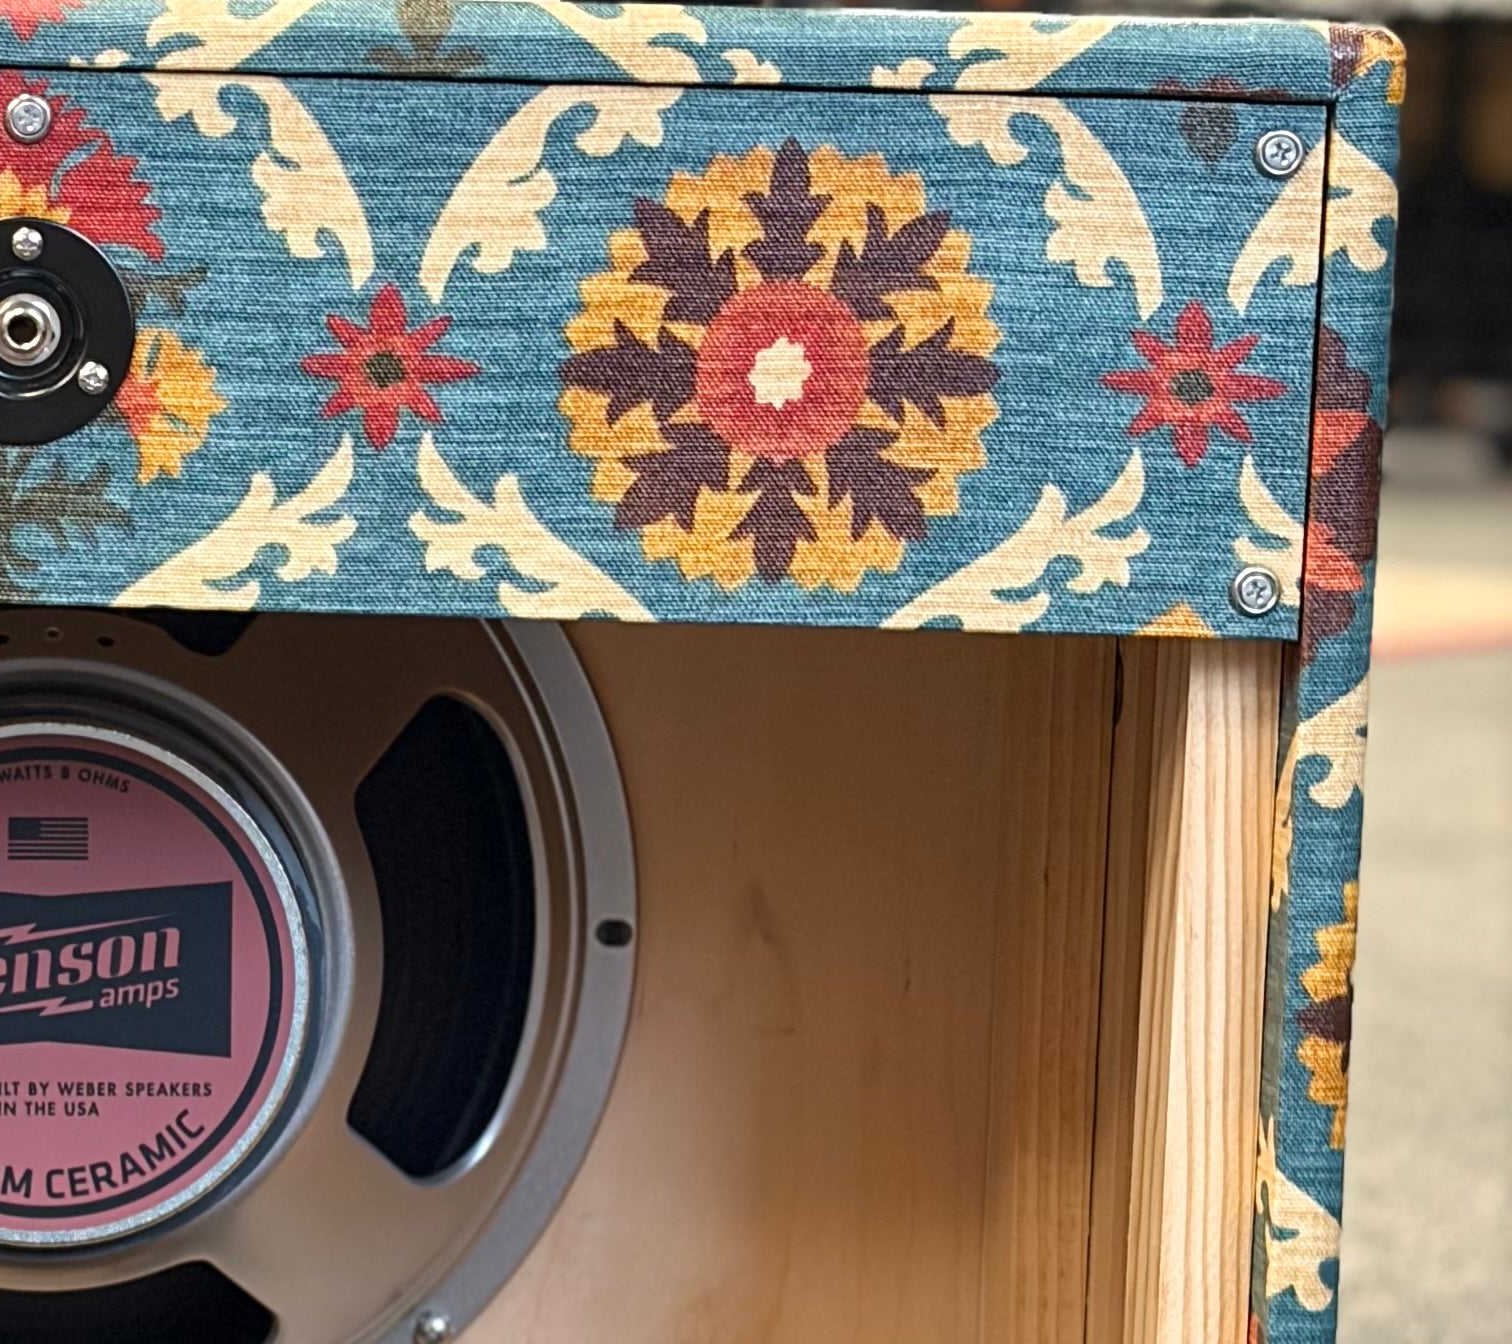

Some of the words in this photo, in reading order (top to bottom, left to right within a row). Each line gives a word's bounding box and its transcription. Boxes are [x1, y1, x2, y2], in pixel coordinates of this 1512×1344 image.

[60, 766, 70, 780] 8
[77, 768, 131, 793] OHMS
[100, 976, 180, 1011] amps
[28, 1081, 50, 1097] BY
[58, 1081, 117, 1098] WEBER
[125, 1082, 213, 1098] SPEAKERS
[24, 1101, 58, 1118] THE
[64, 1101, 100, 1118] USA
[46, 1108, 206, 1199] CERAMIC
